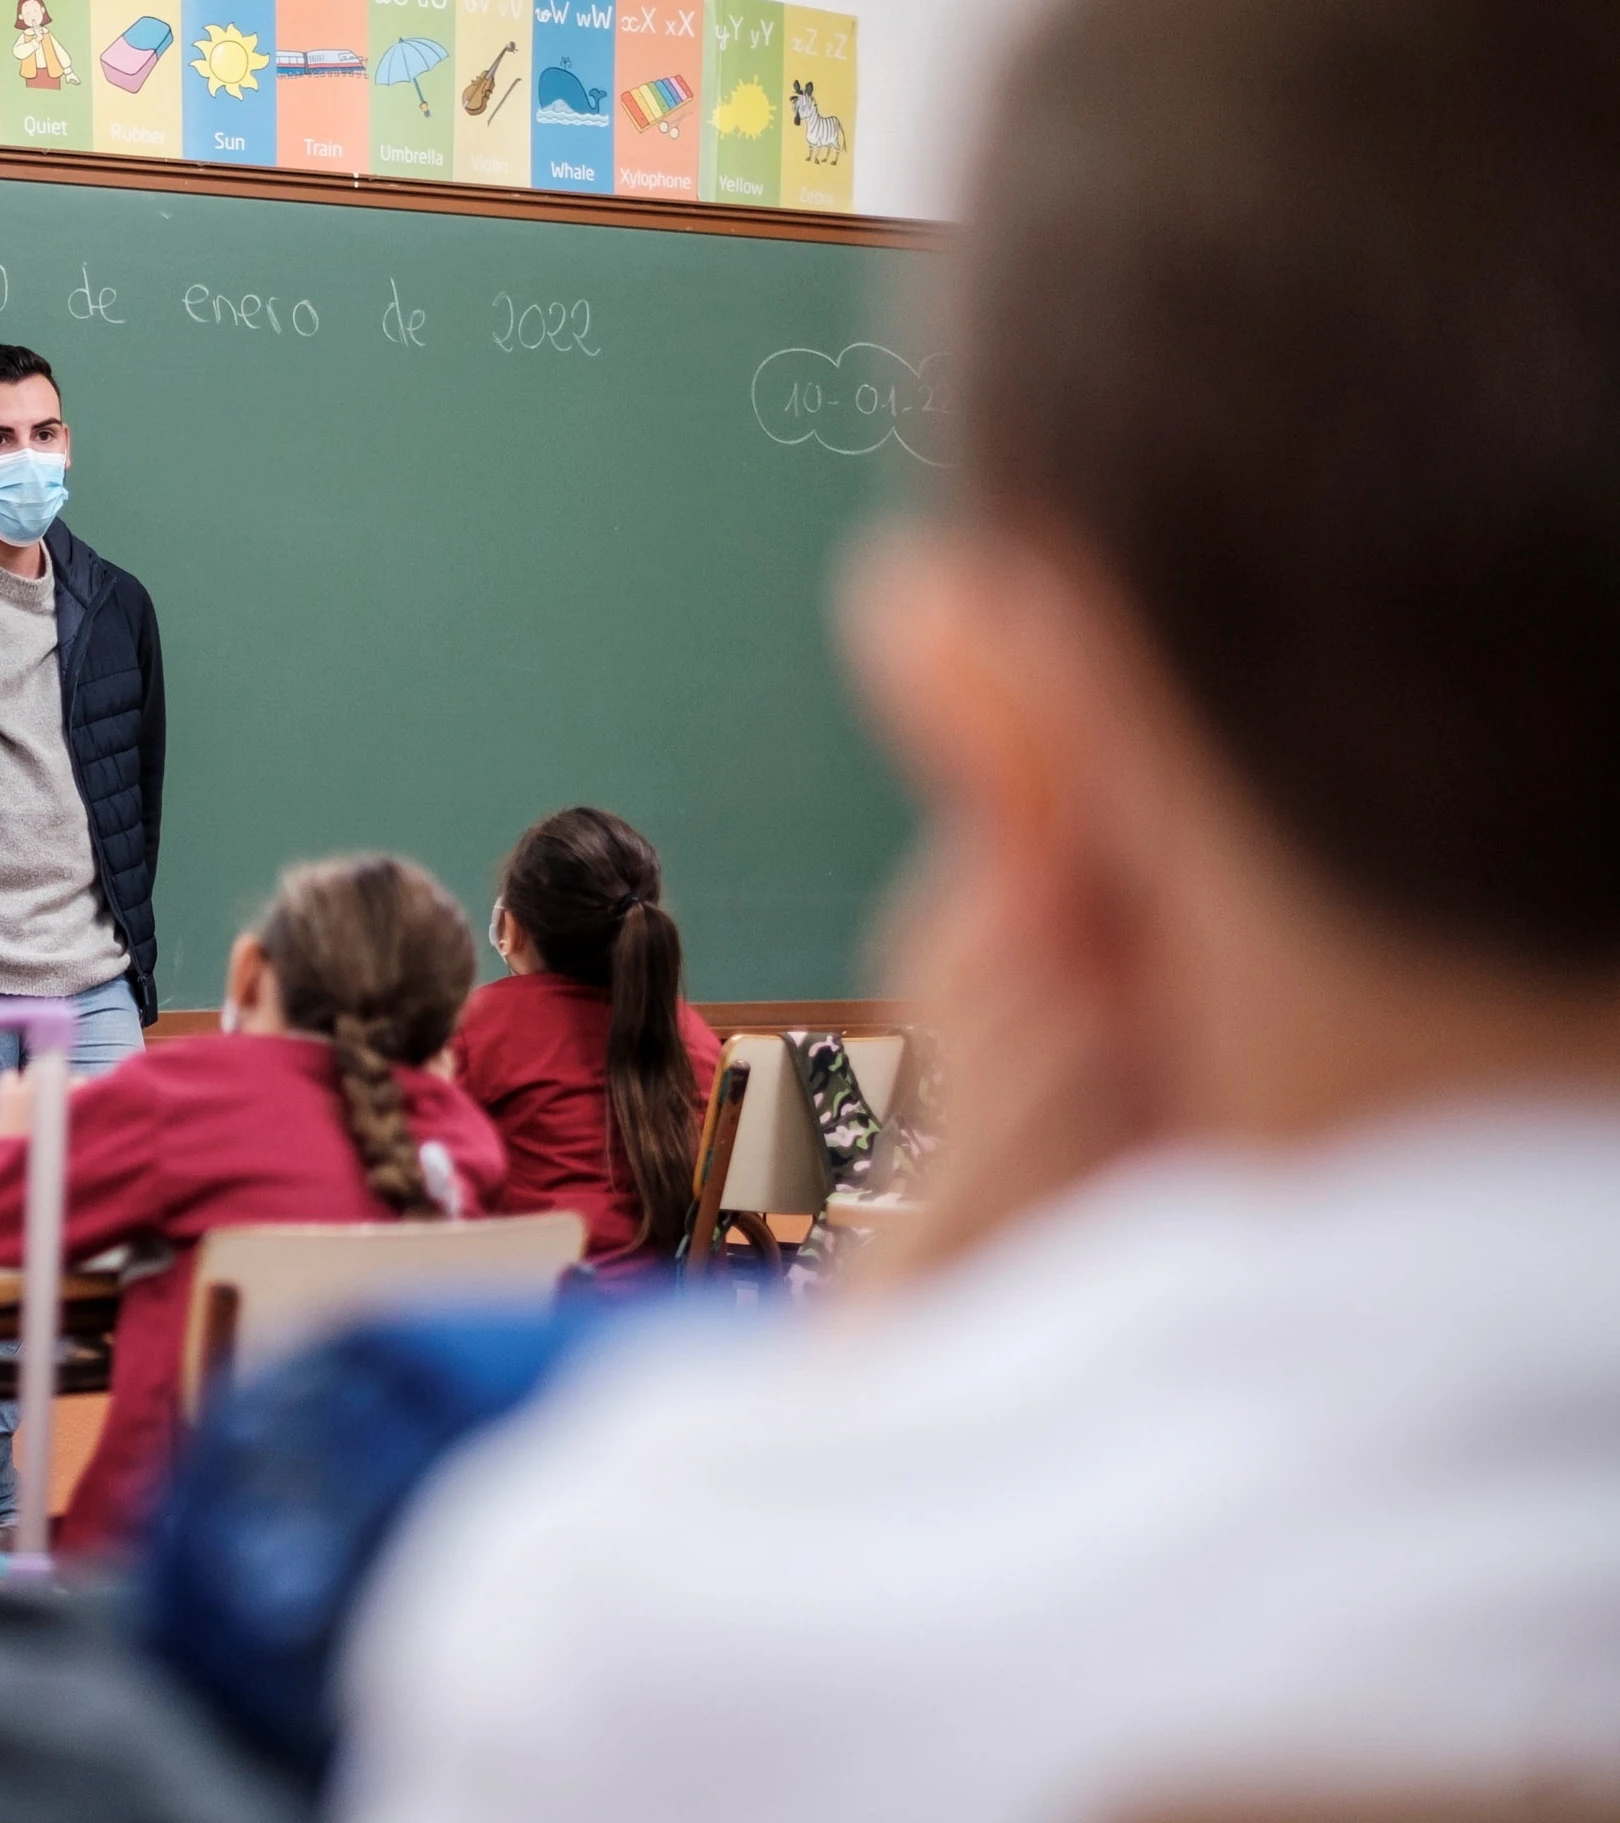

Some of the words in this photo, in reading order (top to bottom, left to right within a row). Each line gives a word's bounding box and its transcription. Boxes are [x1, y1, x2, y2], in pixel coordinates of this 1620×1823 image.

[576, 4, 613, 29] wW
[664, 9, 696, 38] xX
[750, 19, 775, 49] yY
[23, 116, 68, 138] Quiet
[109, 122, 166, 146] Rubber
[214, 132, 246, 152] Sun
[303, 138, 343, 159] Train
[380, 145, 444, 167] Umbrella
[470, 151, 509, 175] Violin
[550, 161, 596, 183] Whale
[620, 168, 692, 191] Xylophone
[718, 174, 764, 197] Yellow
[67, 261, 127, 324] de
[181, 283, 319, 337] enero
[382, 276, 427, 348] de
[490, 290, 602, 357] 2022
